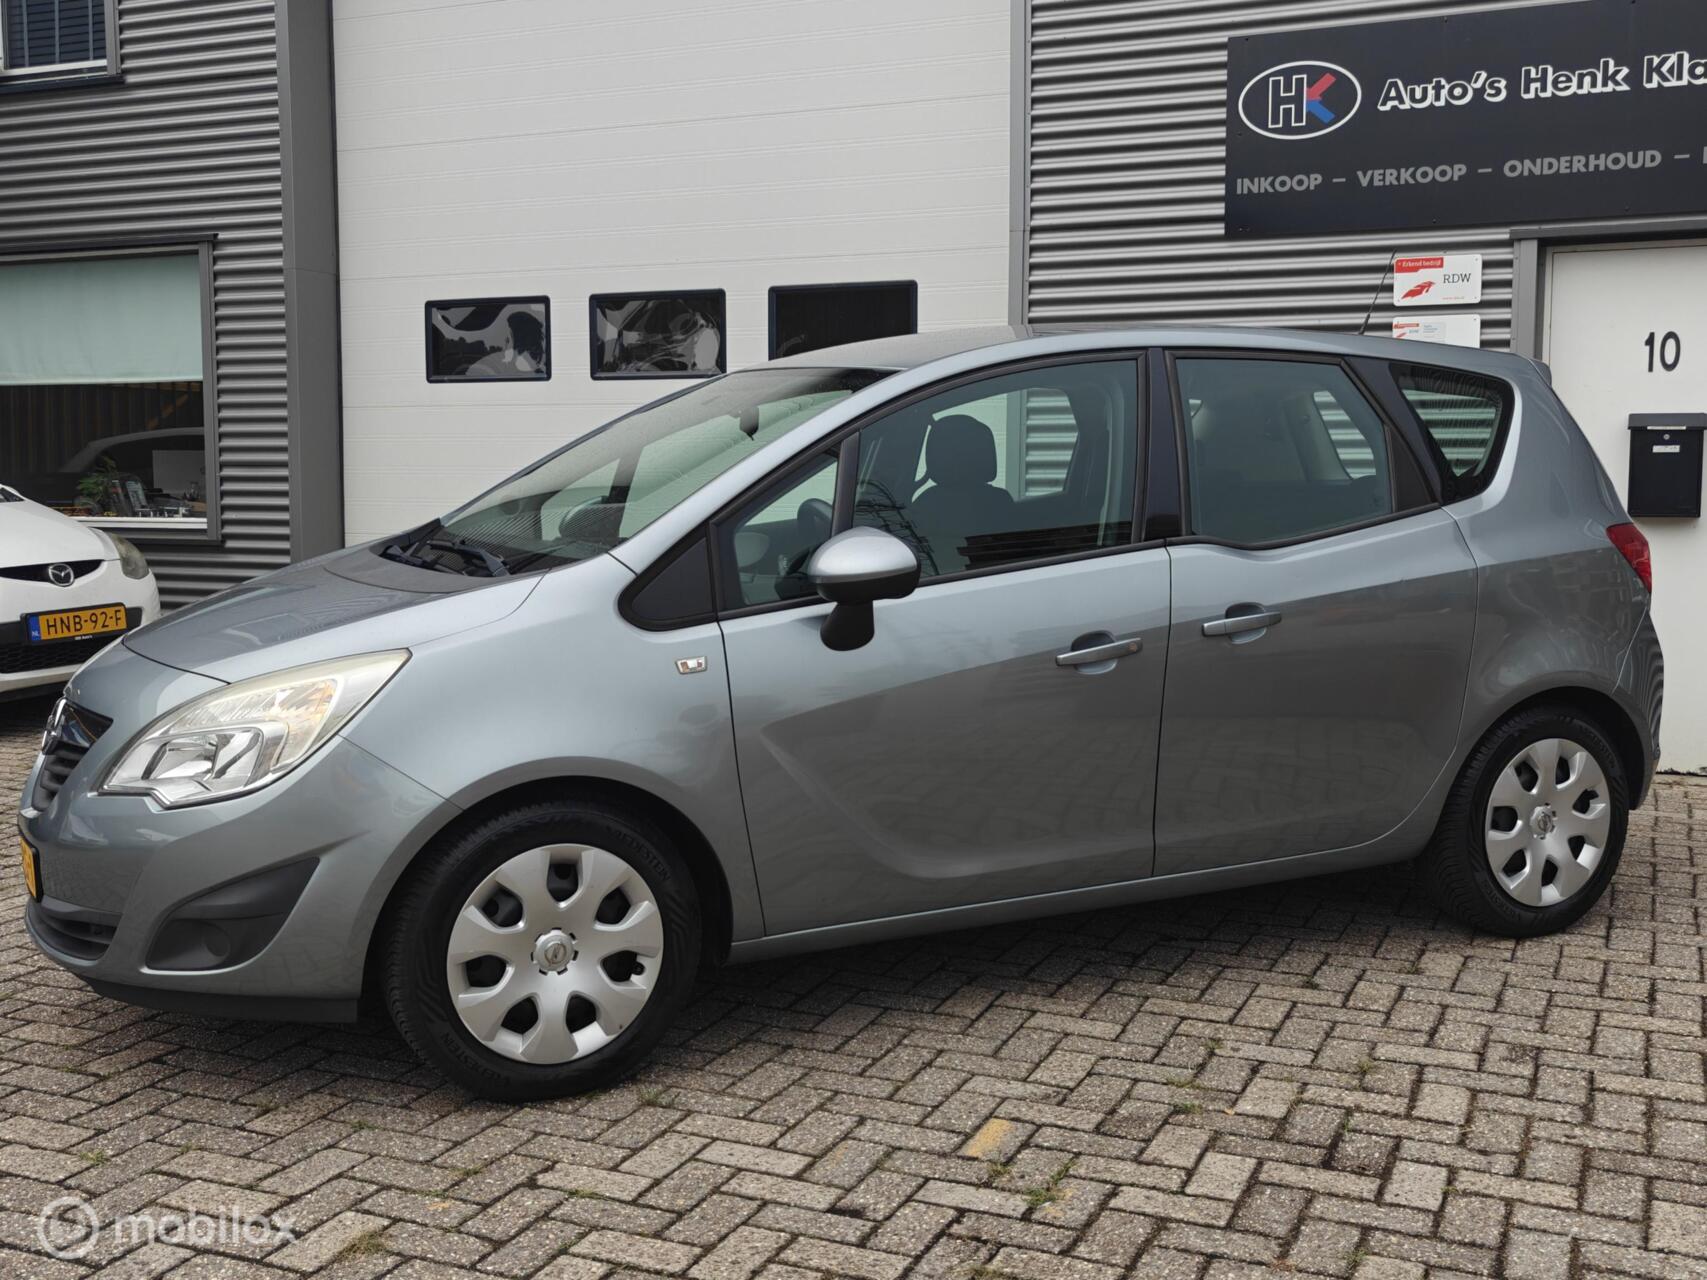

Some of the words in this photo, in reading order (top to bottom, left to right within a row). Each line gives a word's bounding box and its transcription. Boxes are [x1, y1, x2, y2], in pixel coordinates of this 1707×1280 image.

[1268, 72, 1337, 129] HK
[1376, 70, 1507, 111] Auto's
[1520, 57, 1631, 99] Henk
[1236, 173, 1323, 195] INKOOP
[1356, 163, 1468, 188] VERKOOP
[1503, 149, 1662, 179] ONDERHOUD
[1443, 272, 1472, 284] RDW
[1644, 330, 1681, 373] 10
[46, 609, 122, 636] HNB-92-F
